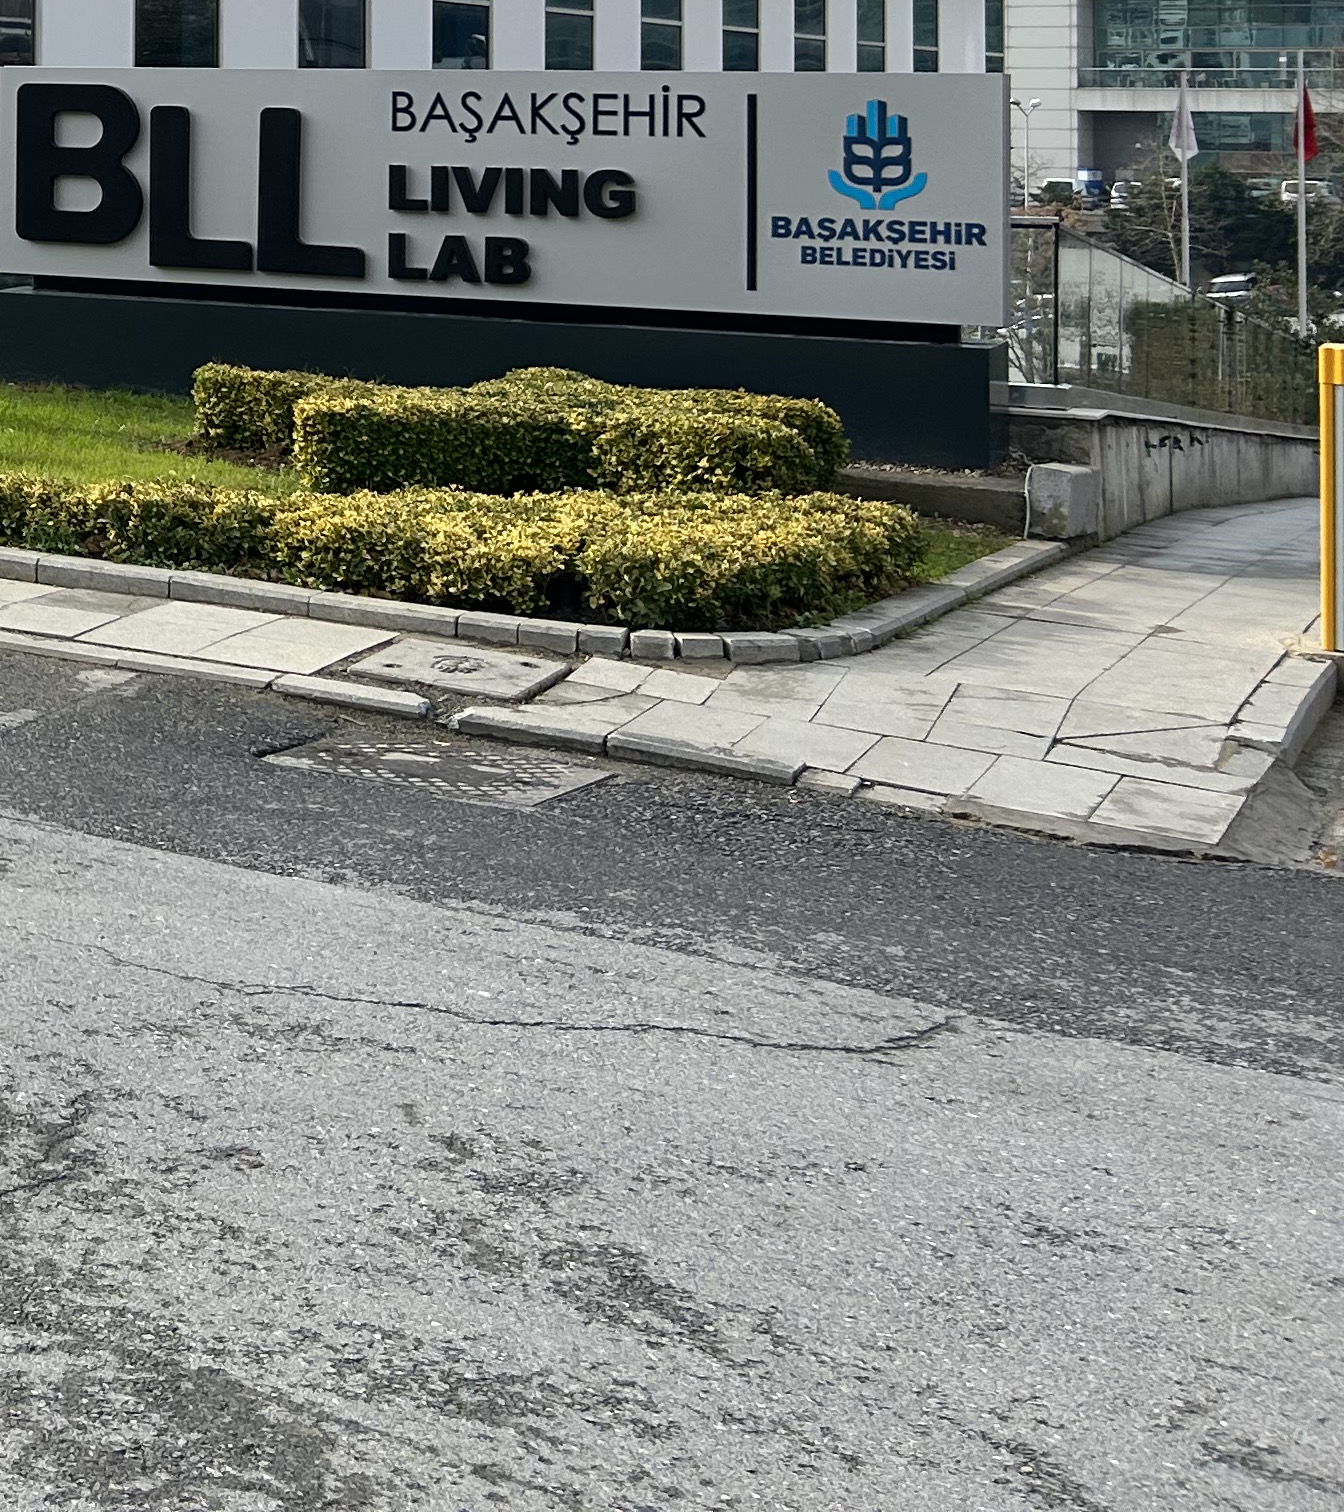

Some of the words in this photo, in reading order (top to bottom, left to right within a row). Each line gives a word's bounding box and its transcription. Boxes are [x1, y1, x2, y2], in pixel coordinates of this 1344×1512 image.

[390, 84, 707, 145] BAŞAKŞEHİR
[15, 82, 366, 279] BLL
[388, 164, 638, 219] LIVING
[388, 232, 533, 284] LAB
